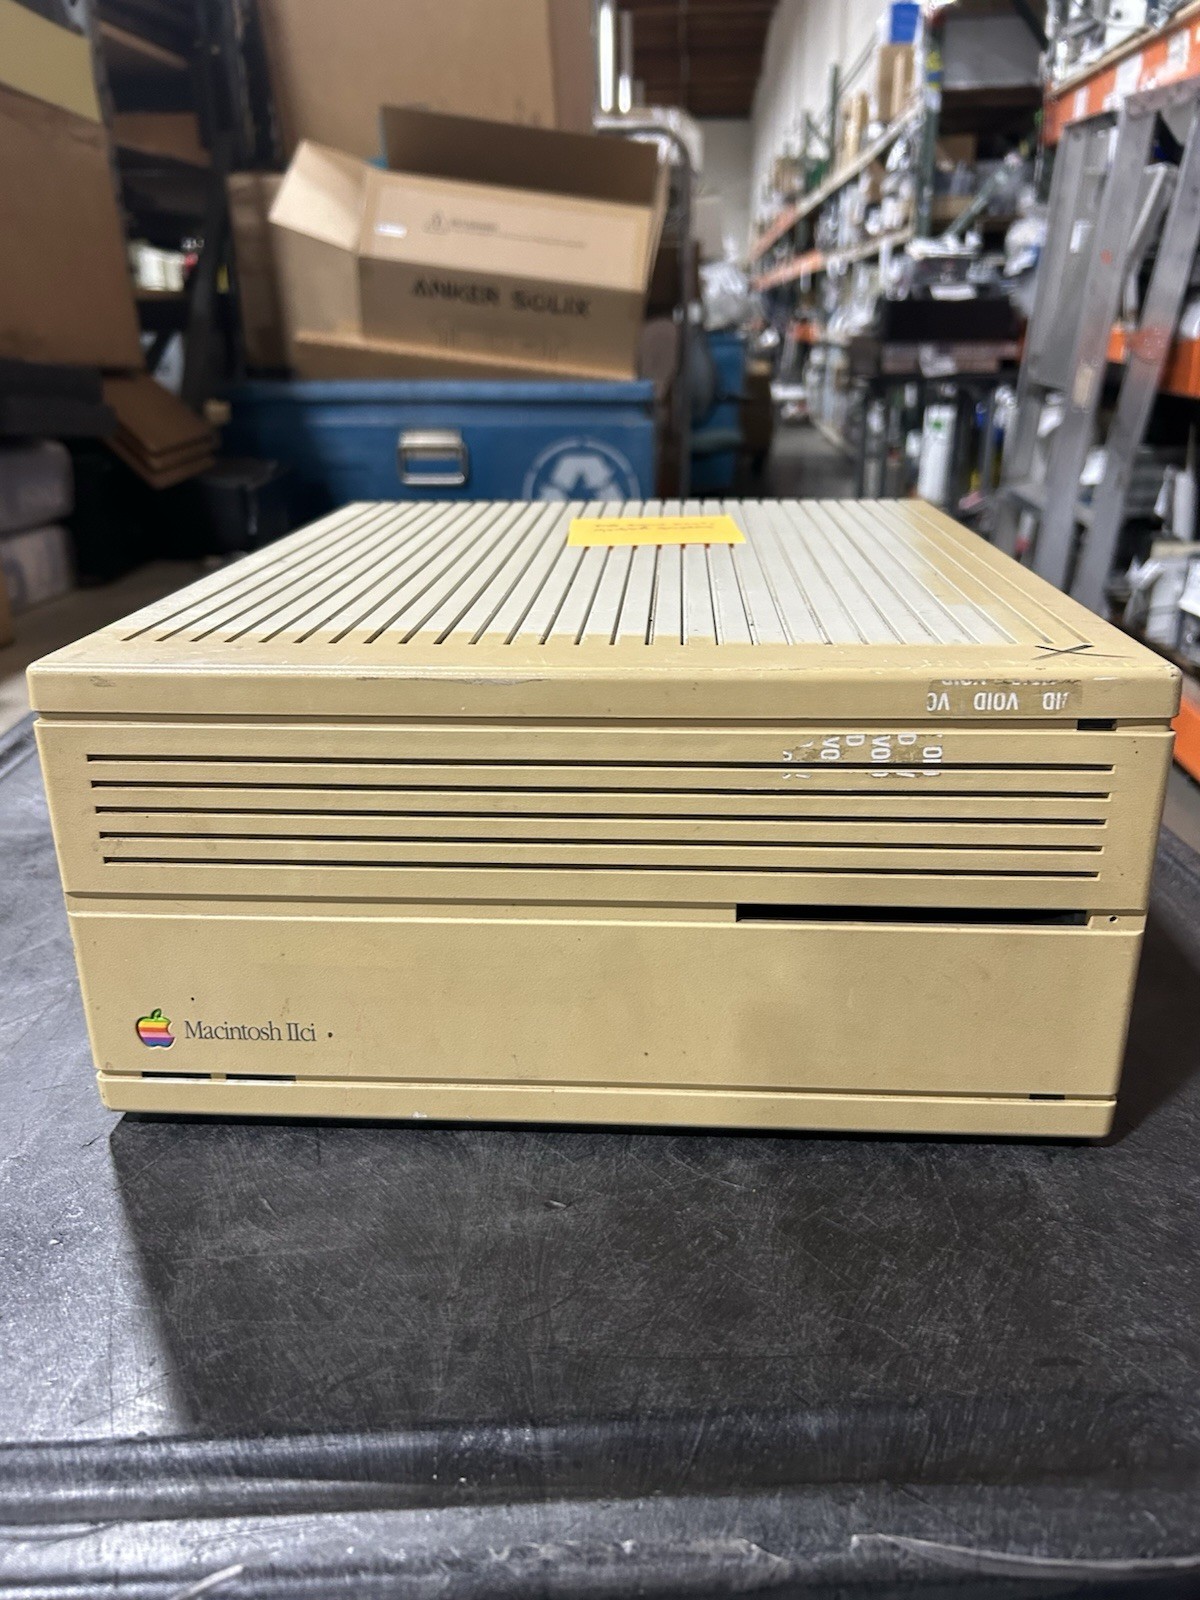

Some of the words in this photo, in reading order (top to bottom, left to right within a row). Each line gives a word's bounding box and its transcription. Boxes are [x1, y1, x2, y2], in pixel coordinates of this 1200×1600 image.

[973, 692, 1019, 711] VOID
[184, 1020, 283, 1041] Macintosh
[286, 1022, 317, 1042] IIci
